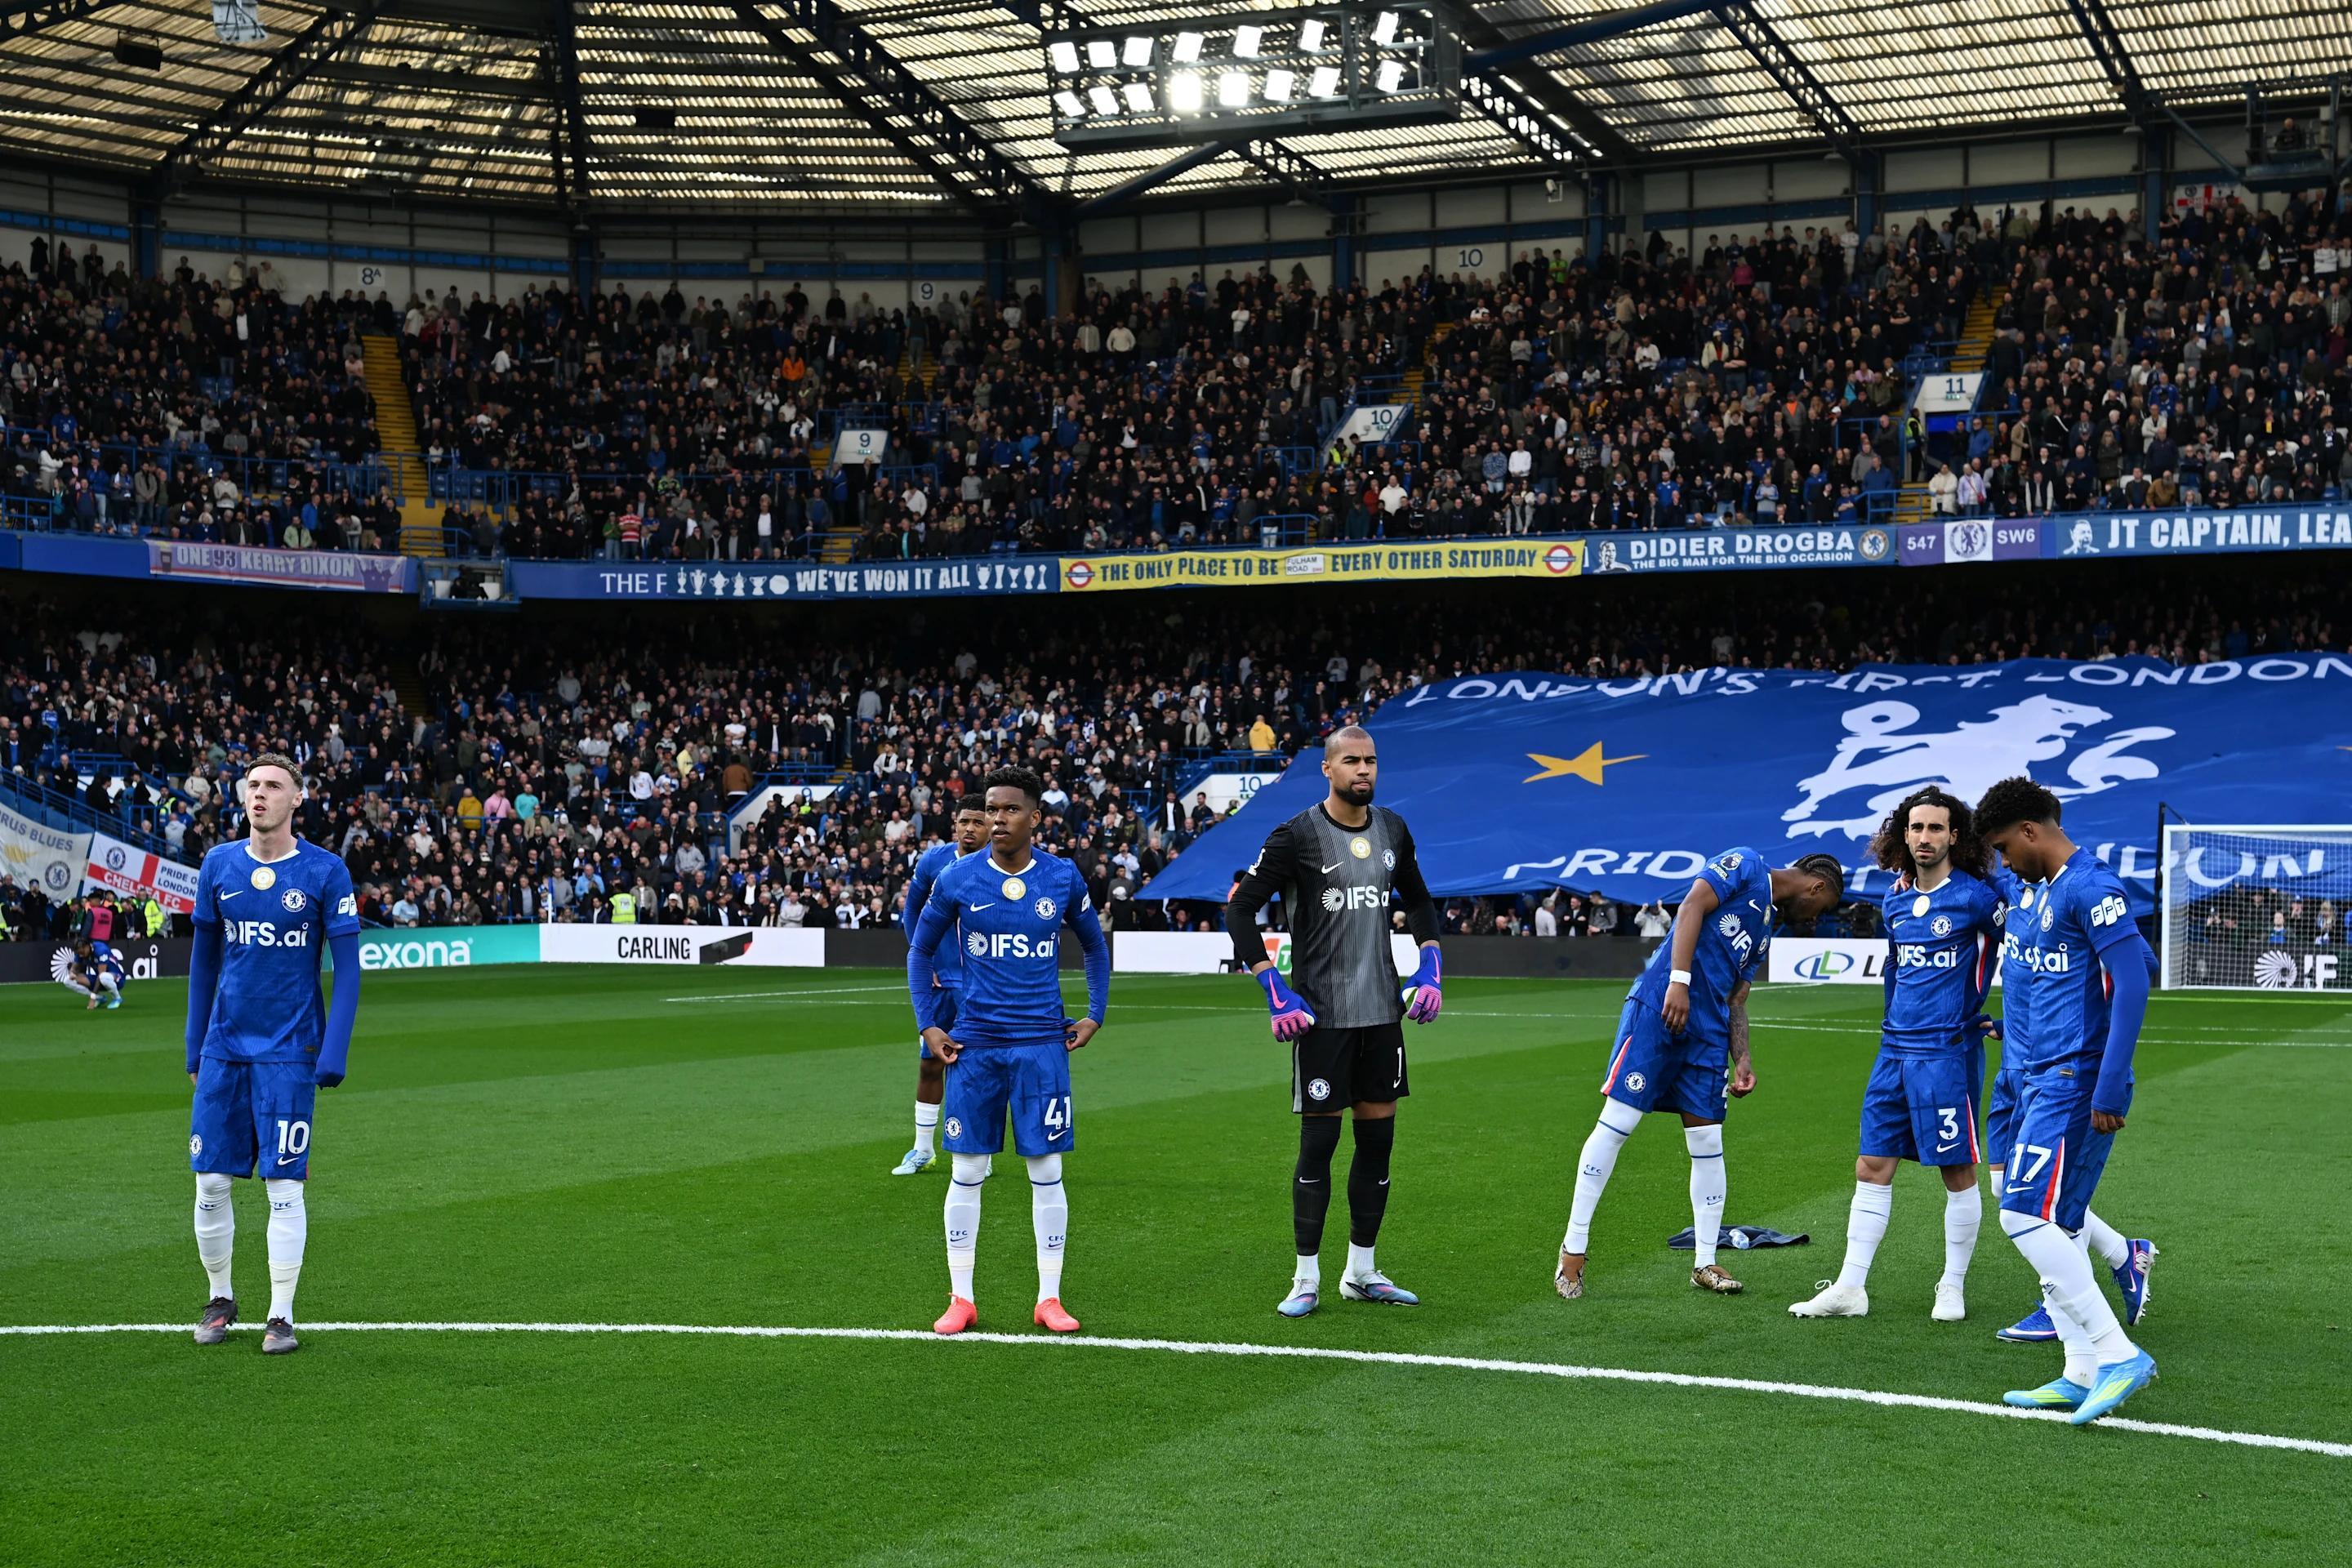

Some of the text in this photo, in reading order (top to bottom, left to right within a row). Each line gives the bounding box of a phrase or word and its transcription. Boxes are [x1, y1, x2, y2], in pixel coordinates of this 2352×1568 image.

[1459, 248, 1483, 268] 10
[362, 267, 381, 285] 8A
[921, 283, 933, 300] 9
[1946, 378, 1966, 394] 11
[1371, 409, 1392, 425] 10
[859, 433, 871, 448] 9
[1997, 528, 2036, 545] SW6
[2108, 519, 2140, 548] JT
[2150, 514, 2289, 548] CAPTAIN,
[1630, 537, 1725, 559] DIDIER
[1735, 531, 1855, 554] DROGBA
[1907, 535, 1936, 550] 547
[177, 546, 354, 577] ONE 93 KERRY DIXON
[1100, 549, 1537, 581] THE ONLY PLACE TO BE EVERY OTHER SATURDAY
[1287, 556, 1317, 565] FULHAM
[1287, 564, 1308, 572] ROAD
[1632, 552, 1853, 569] THE BIG MAN FOR THE BIG OCCASION
[600, 573, 649, 594] THE
[796, 564, 970, 592] WE'VE WON IT ALL
[1240, 776, 1262, 792] 10
[29, 829, 74, 852] BLUES
[161, 866, 198, 885] PRIDE O
[158, 878, 196, 897] LONDON
[1348, 885, 1389, 910] IFS.a
[164, 894, 181, 908] FC
[2091, 899, 2125, 924] FPT
[238, 922, 310, 947] IFS.ai
[991, 932, 1056, 958] IFS.ai
[359, 940, 470, 970] exona
[617, 936, 690, 960] CARLING
[1397, 1046, 1402, 1078] 1
[1045, 1096, 1071, 1130] 41
[1938, 1107, 1959, 1140] 3
[278, 1120, 310, 1154] 10
[1586, 1164, 1602, 1174] CFC
[2011, 1143, 2052, 1183] 17
